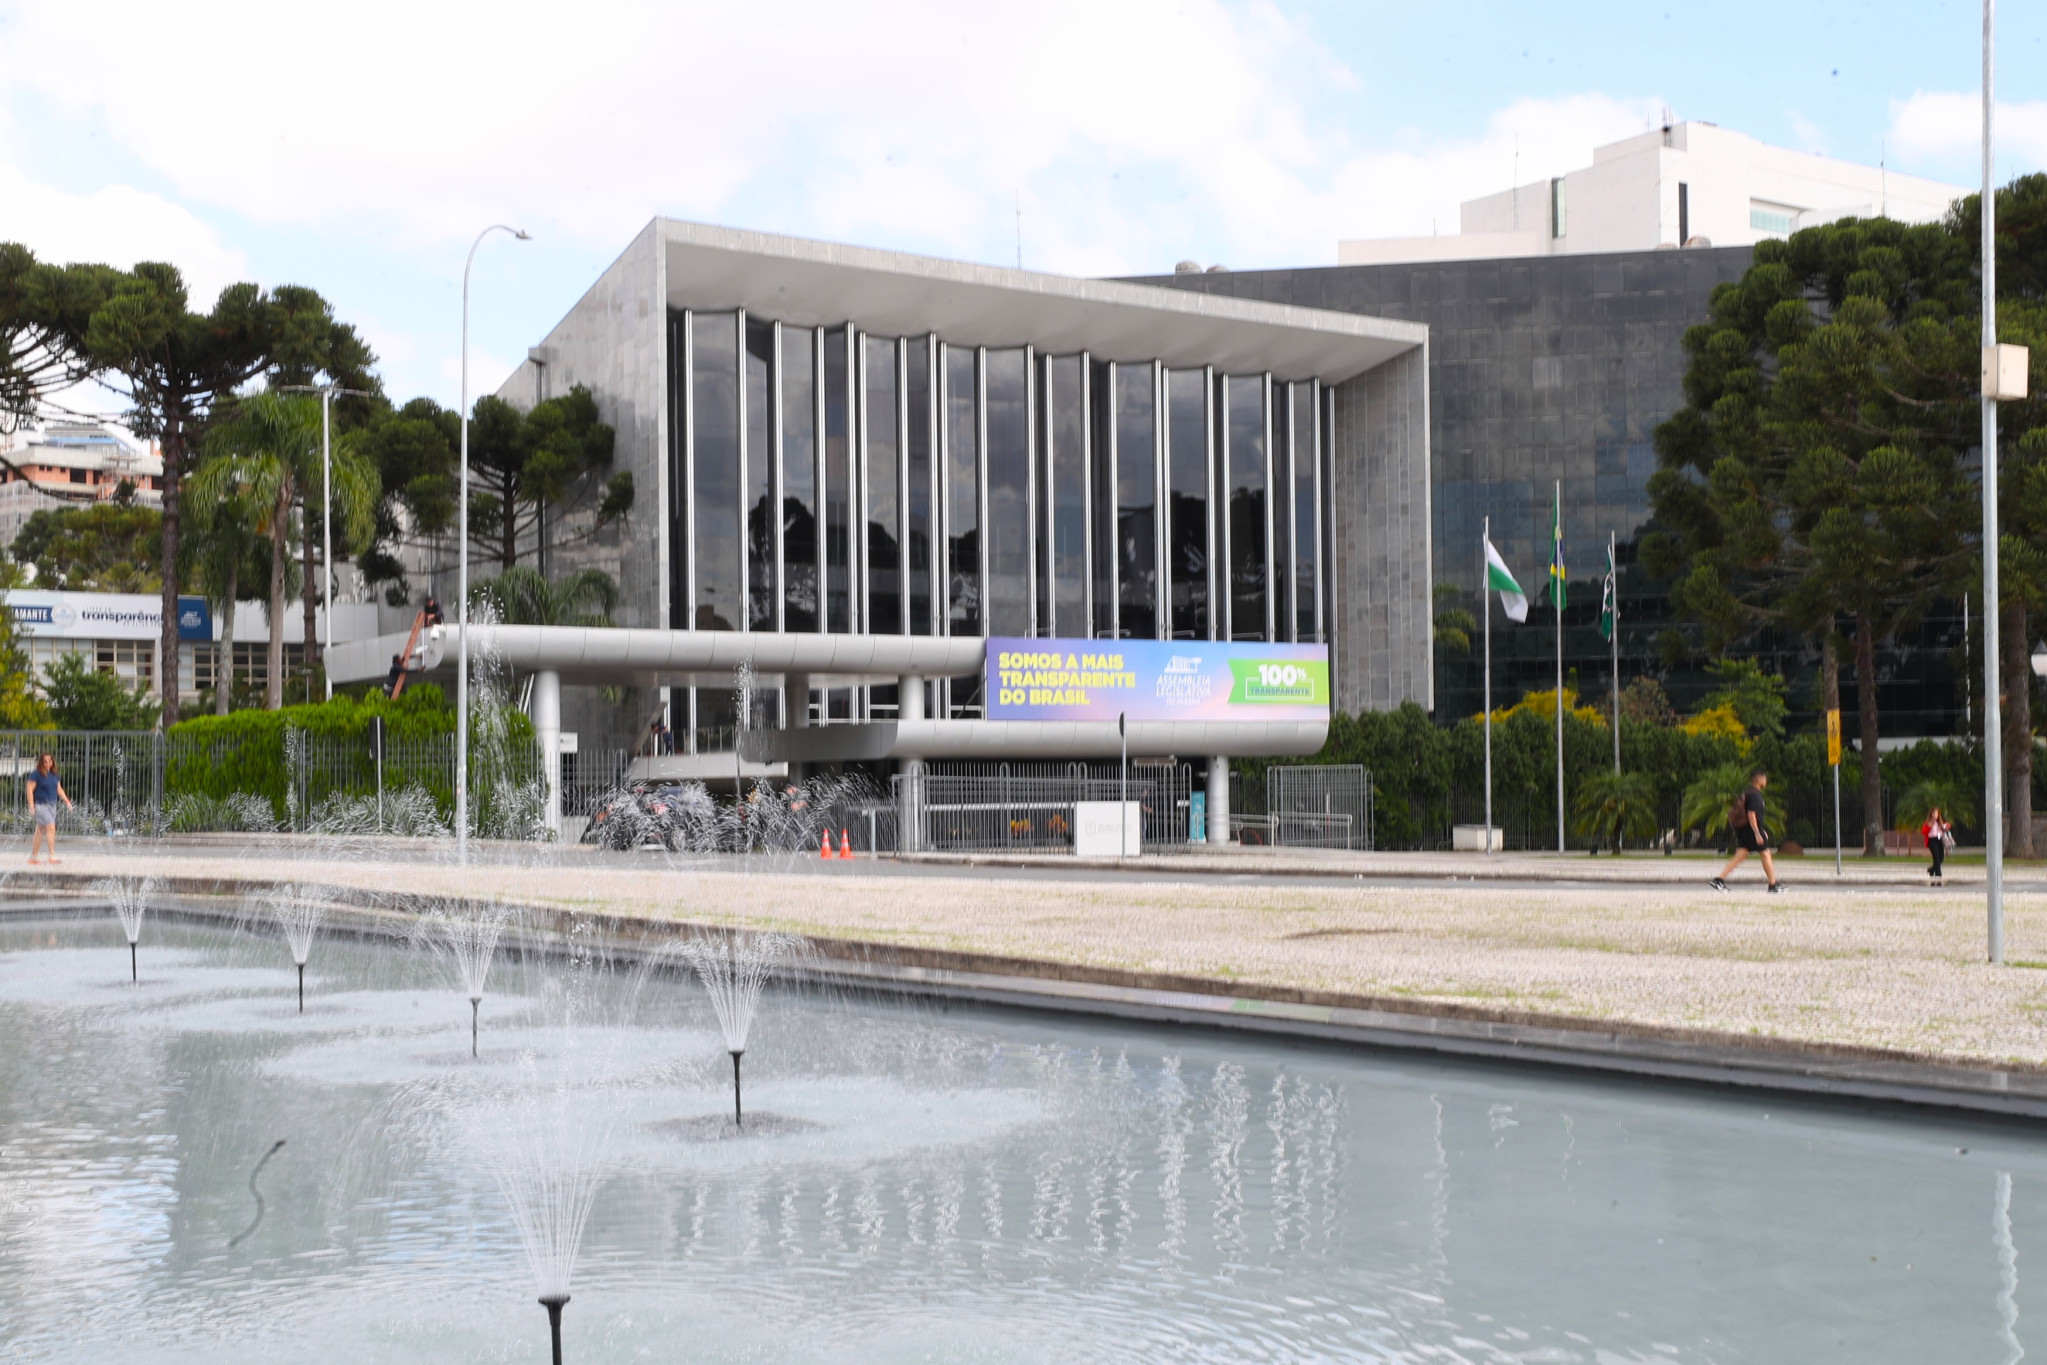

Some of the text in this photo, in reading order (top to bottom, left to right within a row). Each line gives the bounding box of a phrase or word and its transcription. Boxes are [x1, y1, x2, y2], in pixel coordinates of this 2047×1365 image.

[999, 652, 1124, 670] SOMOS A MAIS
[999, 670, 1136, 688] TRANSPARENTE
[1156, 674, 1211, 686] ASSEMBLEIA
[1258, 664, 1307, 687] 100%
[1000, 688, 1090, 705] DO BRASIL
[1156, 686, 1211, 697] LEGISLATIVA
[1250, 686, 1310, 696] TRANSPARENTE
